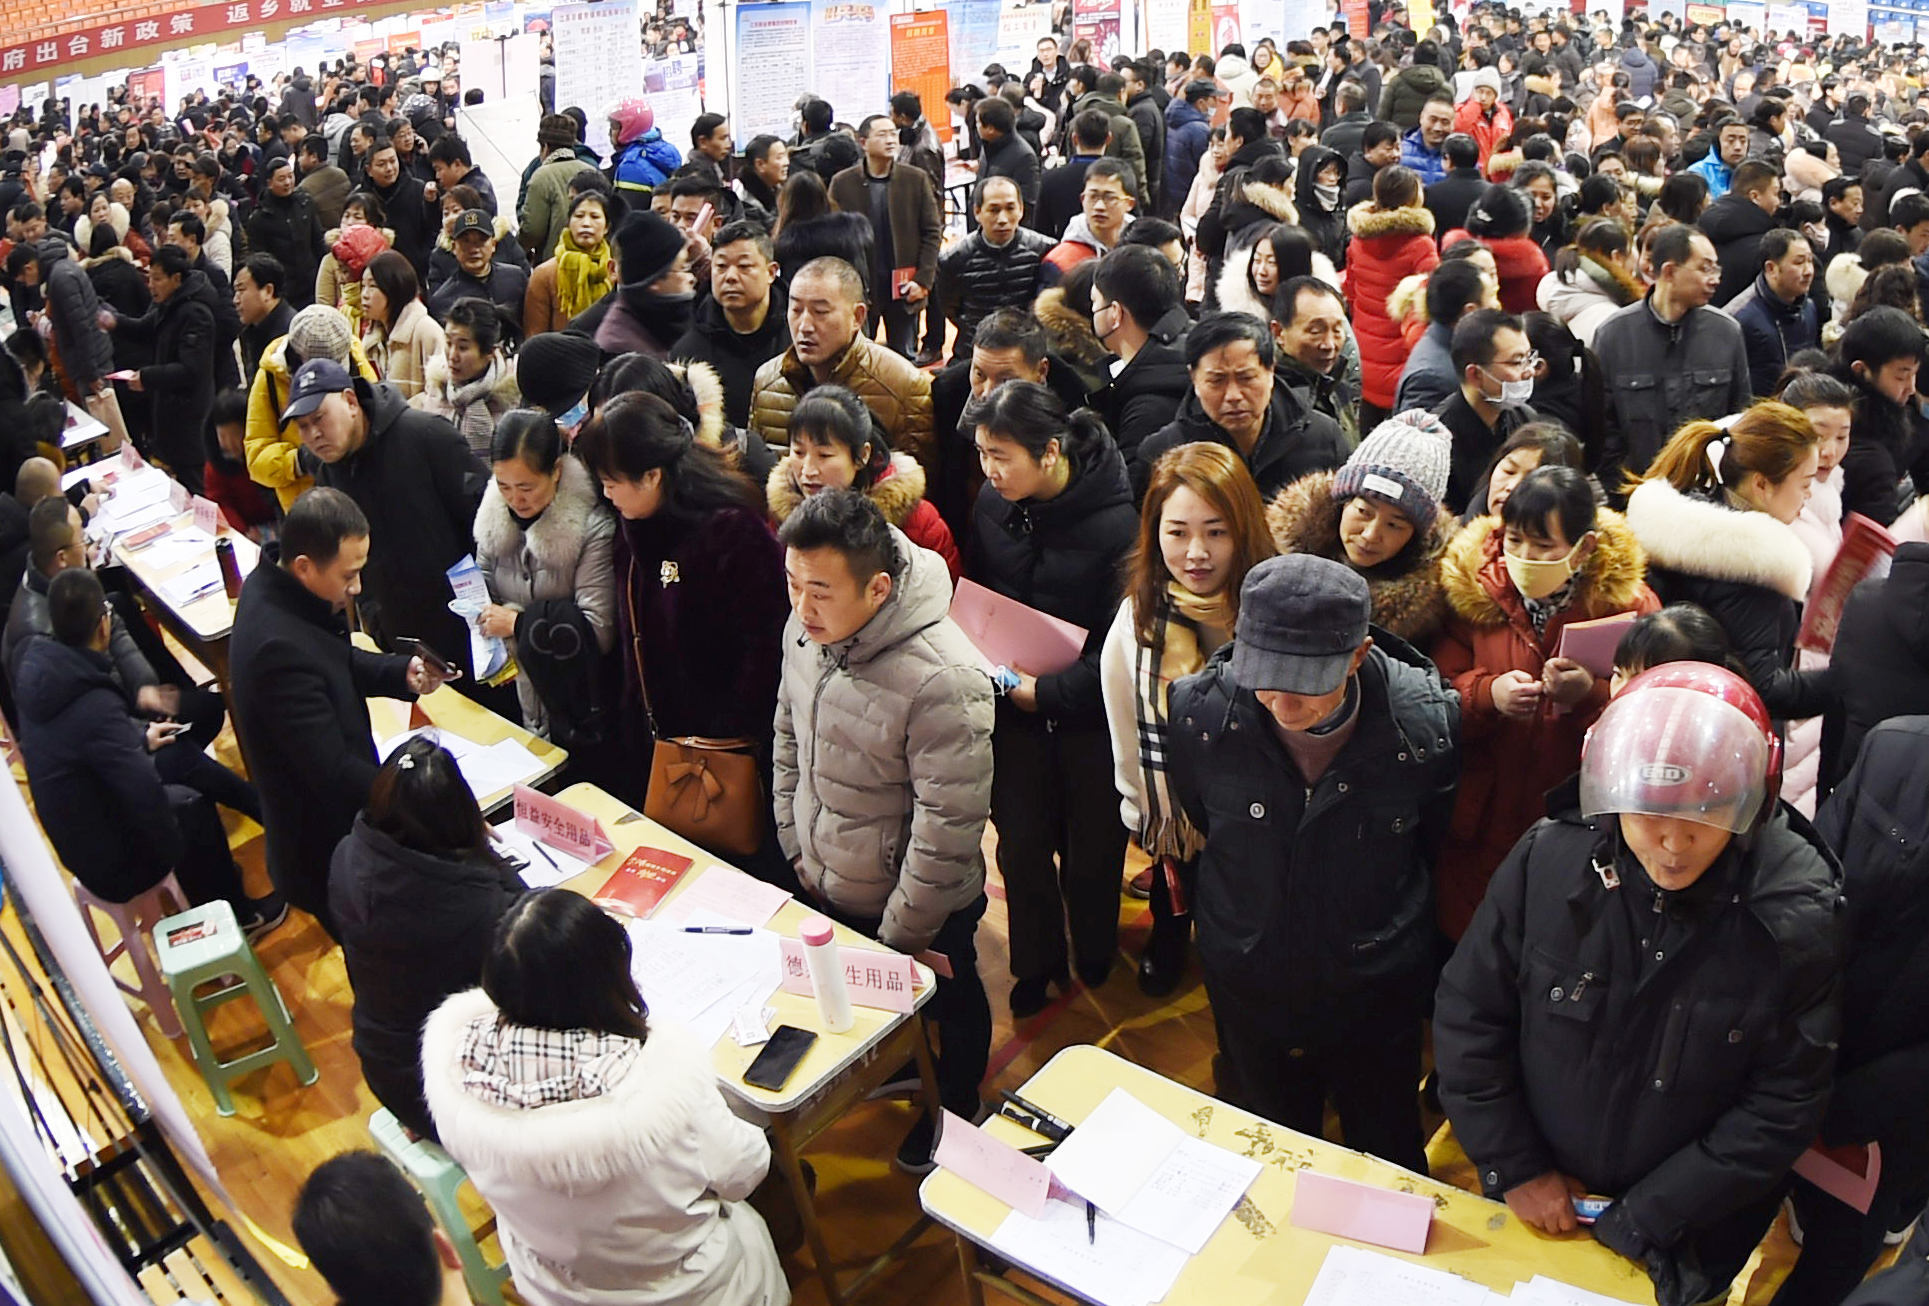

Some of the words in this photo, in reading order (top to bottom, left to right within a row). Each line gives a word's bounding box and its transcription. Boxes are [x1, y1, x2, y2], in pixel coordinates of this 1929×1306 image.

[2, 13, 194, 72] 府出台新政策
[516, 798, 591, 847] 恒益安全用品
[785, 954, 903, 992] 德生用品
